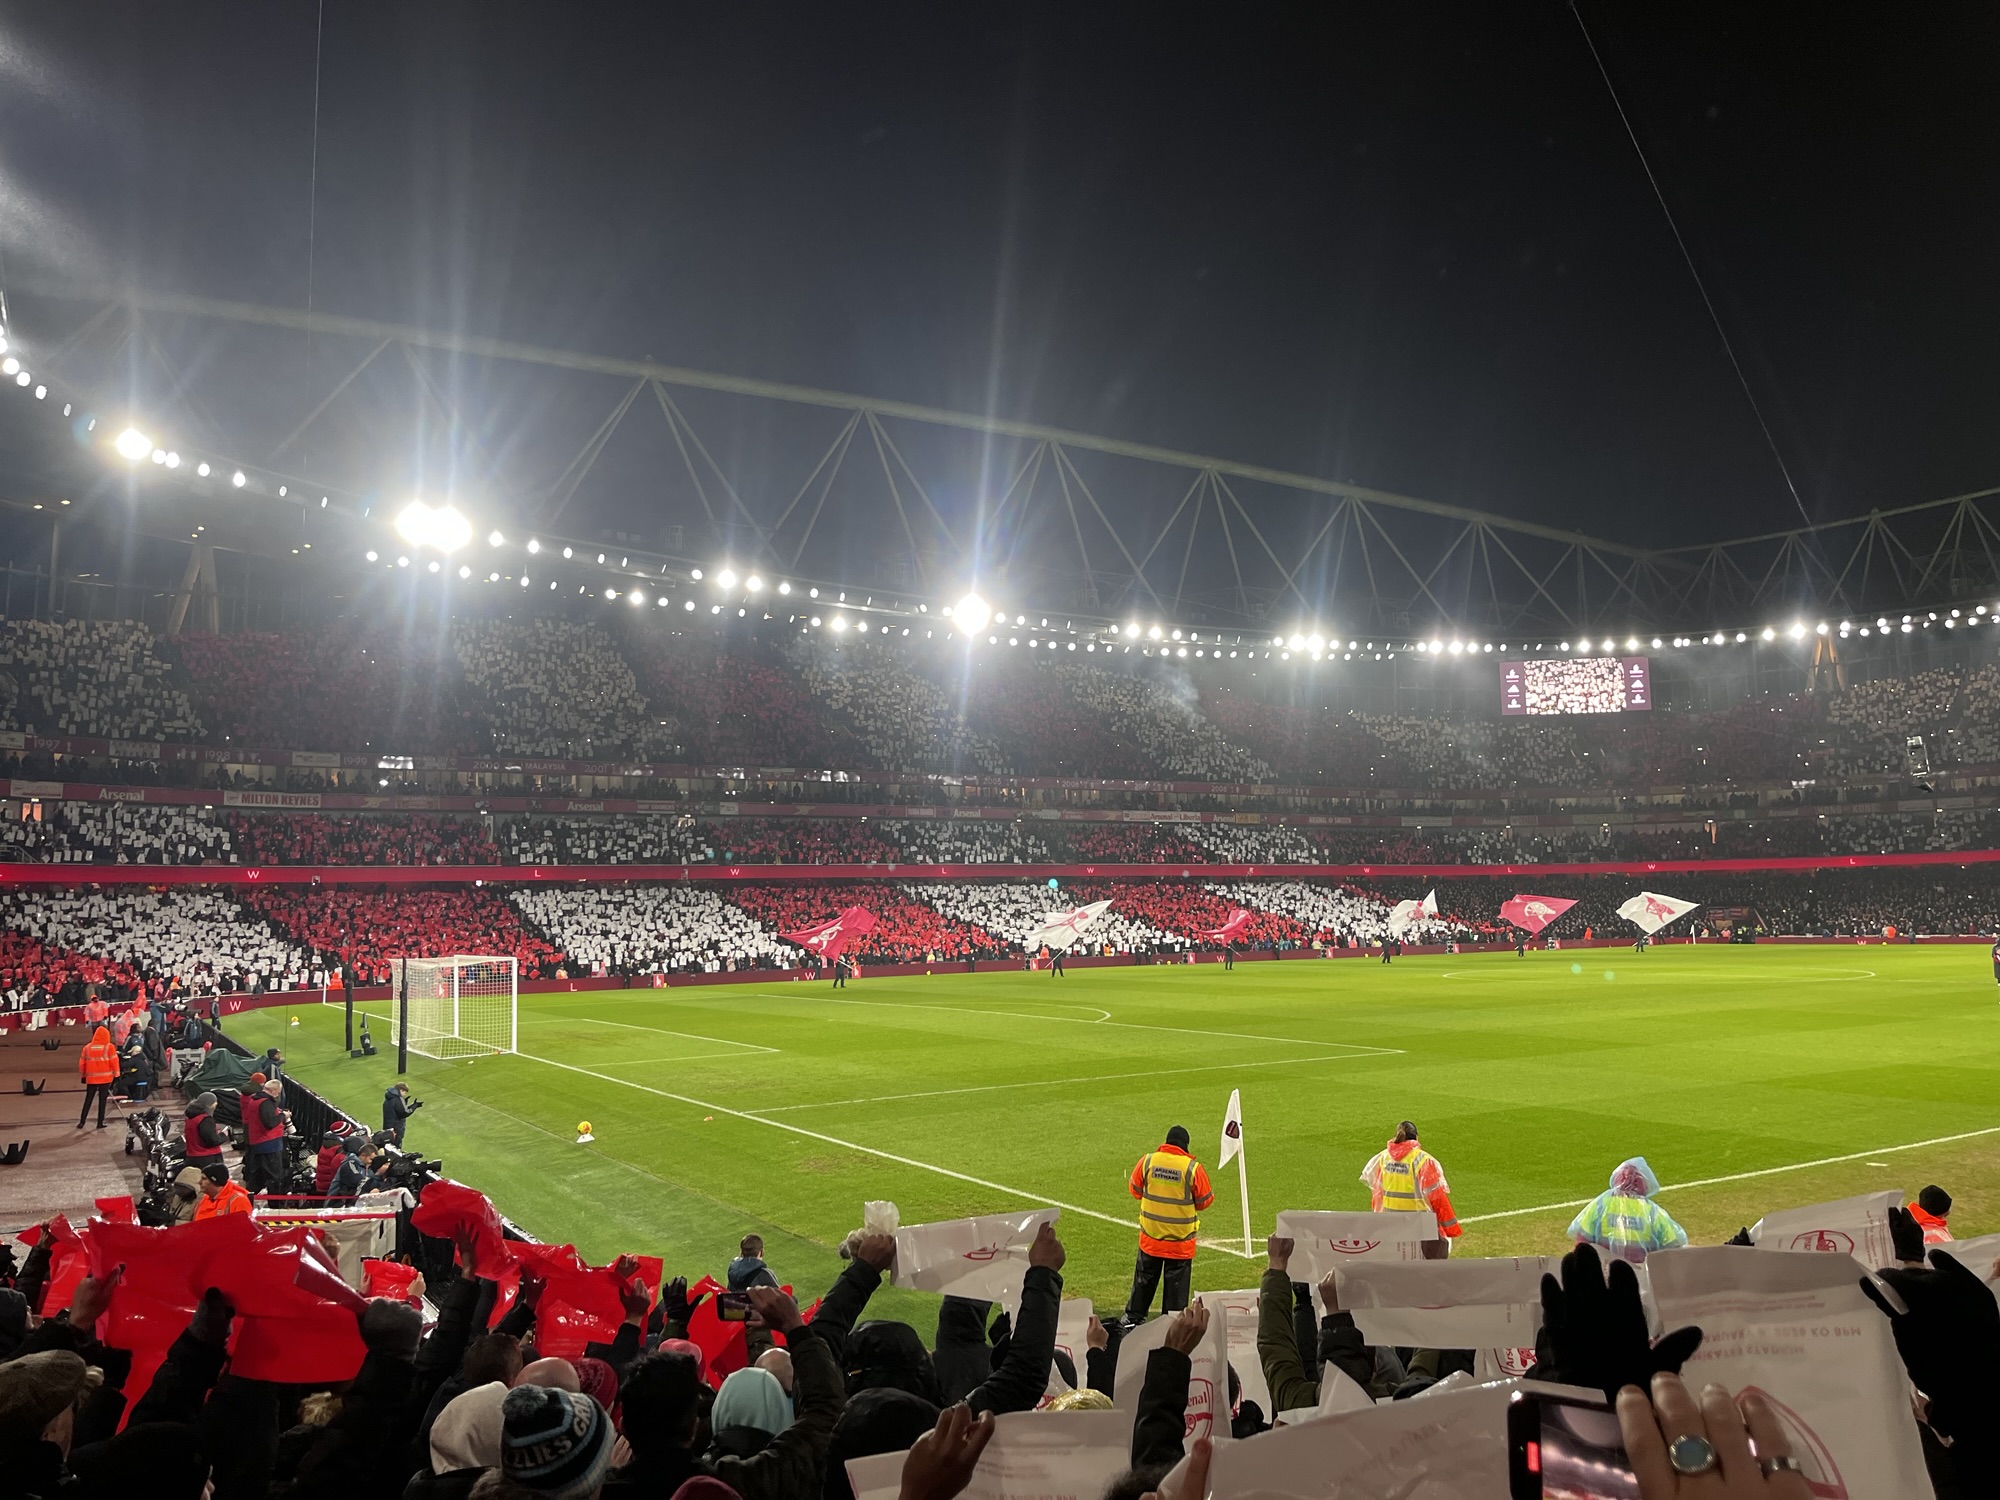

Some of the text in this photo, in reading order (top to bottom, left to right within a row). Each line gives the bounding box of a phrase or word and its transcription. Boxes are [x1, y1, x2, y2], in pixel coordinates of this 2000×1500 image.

[33, 736, 60, 749] 1997
[205, 750, 231, 761] 1998
[344, 756, 367, 766] 1999
[473, 762, 501, 770] 2000
[525, 763, 566, 771] MALAYSIA
[1062, 780, 1081, 788] 2006
[98, 787, 145, 801] Arsenal
[241, 792, 319, 806] MILTON KEYNES
[567, 801, 604, 811] Arsenal
[953, 808, 981, 818] Arsenal
[1150, 812, 1172, 821] Arsenal
[1213, 813, 1236, 823] Arsenal
[247, 871, 260, 879] W
[534, 869, 541, 878] L
[730, 868, 740, 876] W
[1216, 955, 1225, 963] W
[805, 972, 816, 980] W
[570, 982, 578, 992] L
[229, 1000, 242, 1011] W
[1155, 1167, 1178, 1177] ARSENAL
[1154, 1173, 1179, 1182] STEWARD
[1187, 1391, 1208, 1407] enal
